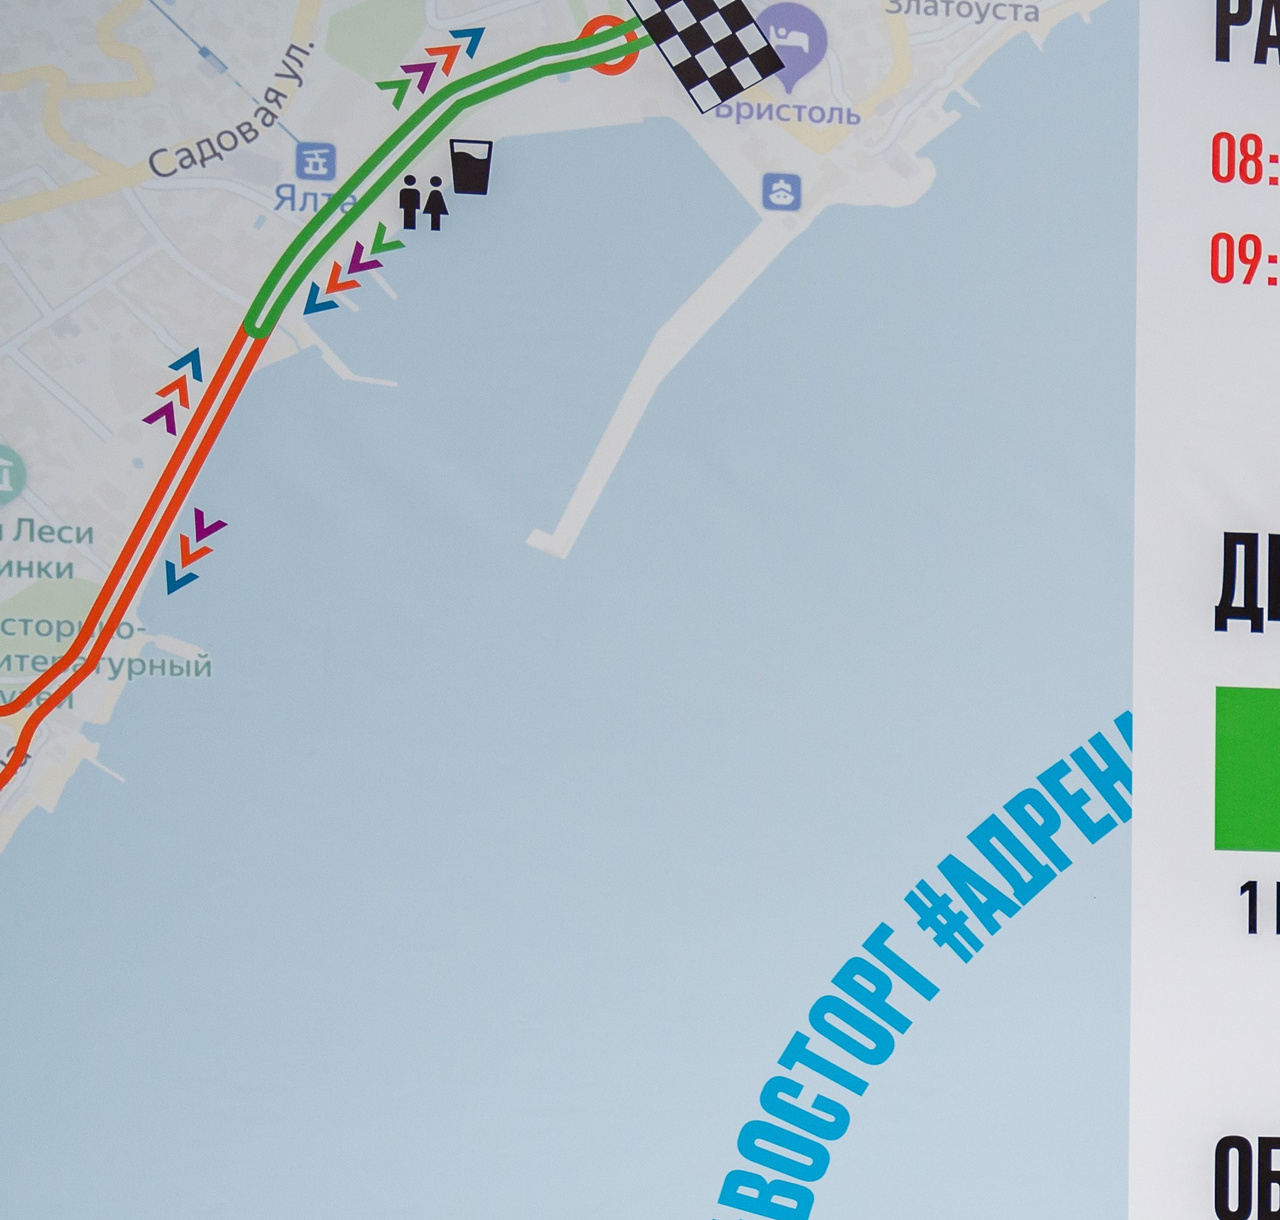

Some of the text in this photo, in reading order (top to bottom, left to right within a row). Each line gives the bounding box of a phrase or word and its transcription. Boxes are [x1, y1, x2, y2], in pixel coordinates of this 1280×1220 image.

[148, 38, 315, 178] Садовая ул.
[13, 517, 93, 544] Леси
[0, 559, 73, 579] инки
[904, 710, 1133, 964] #АДРЕН
[1240, 881, 1257, 934] 1
